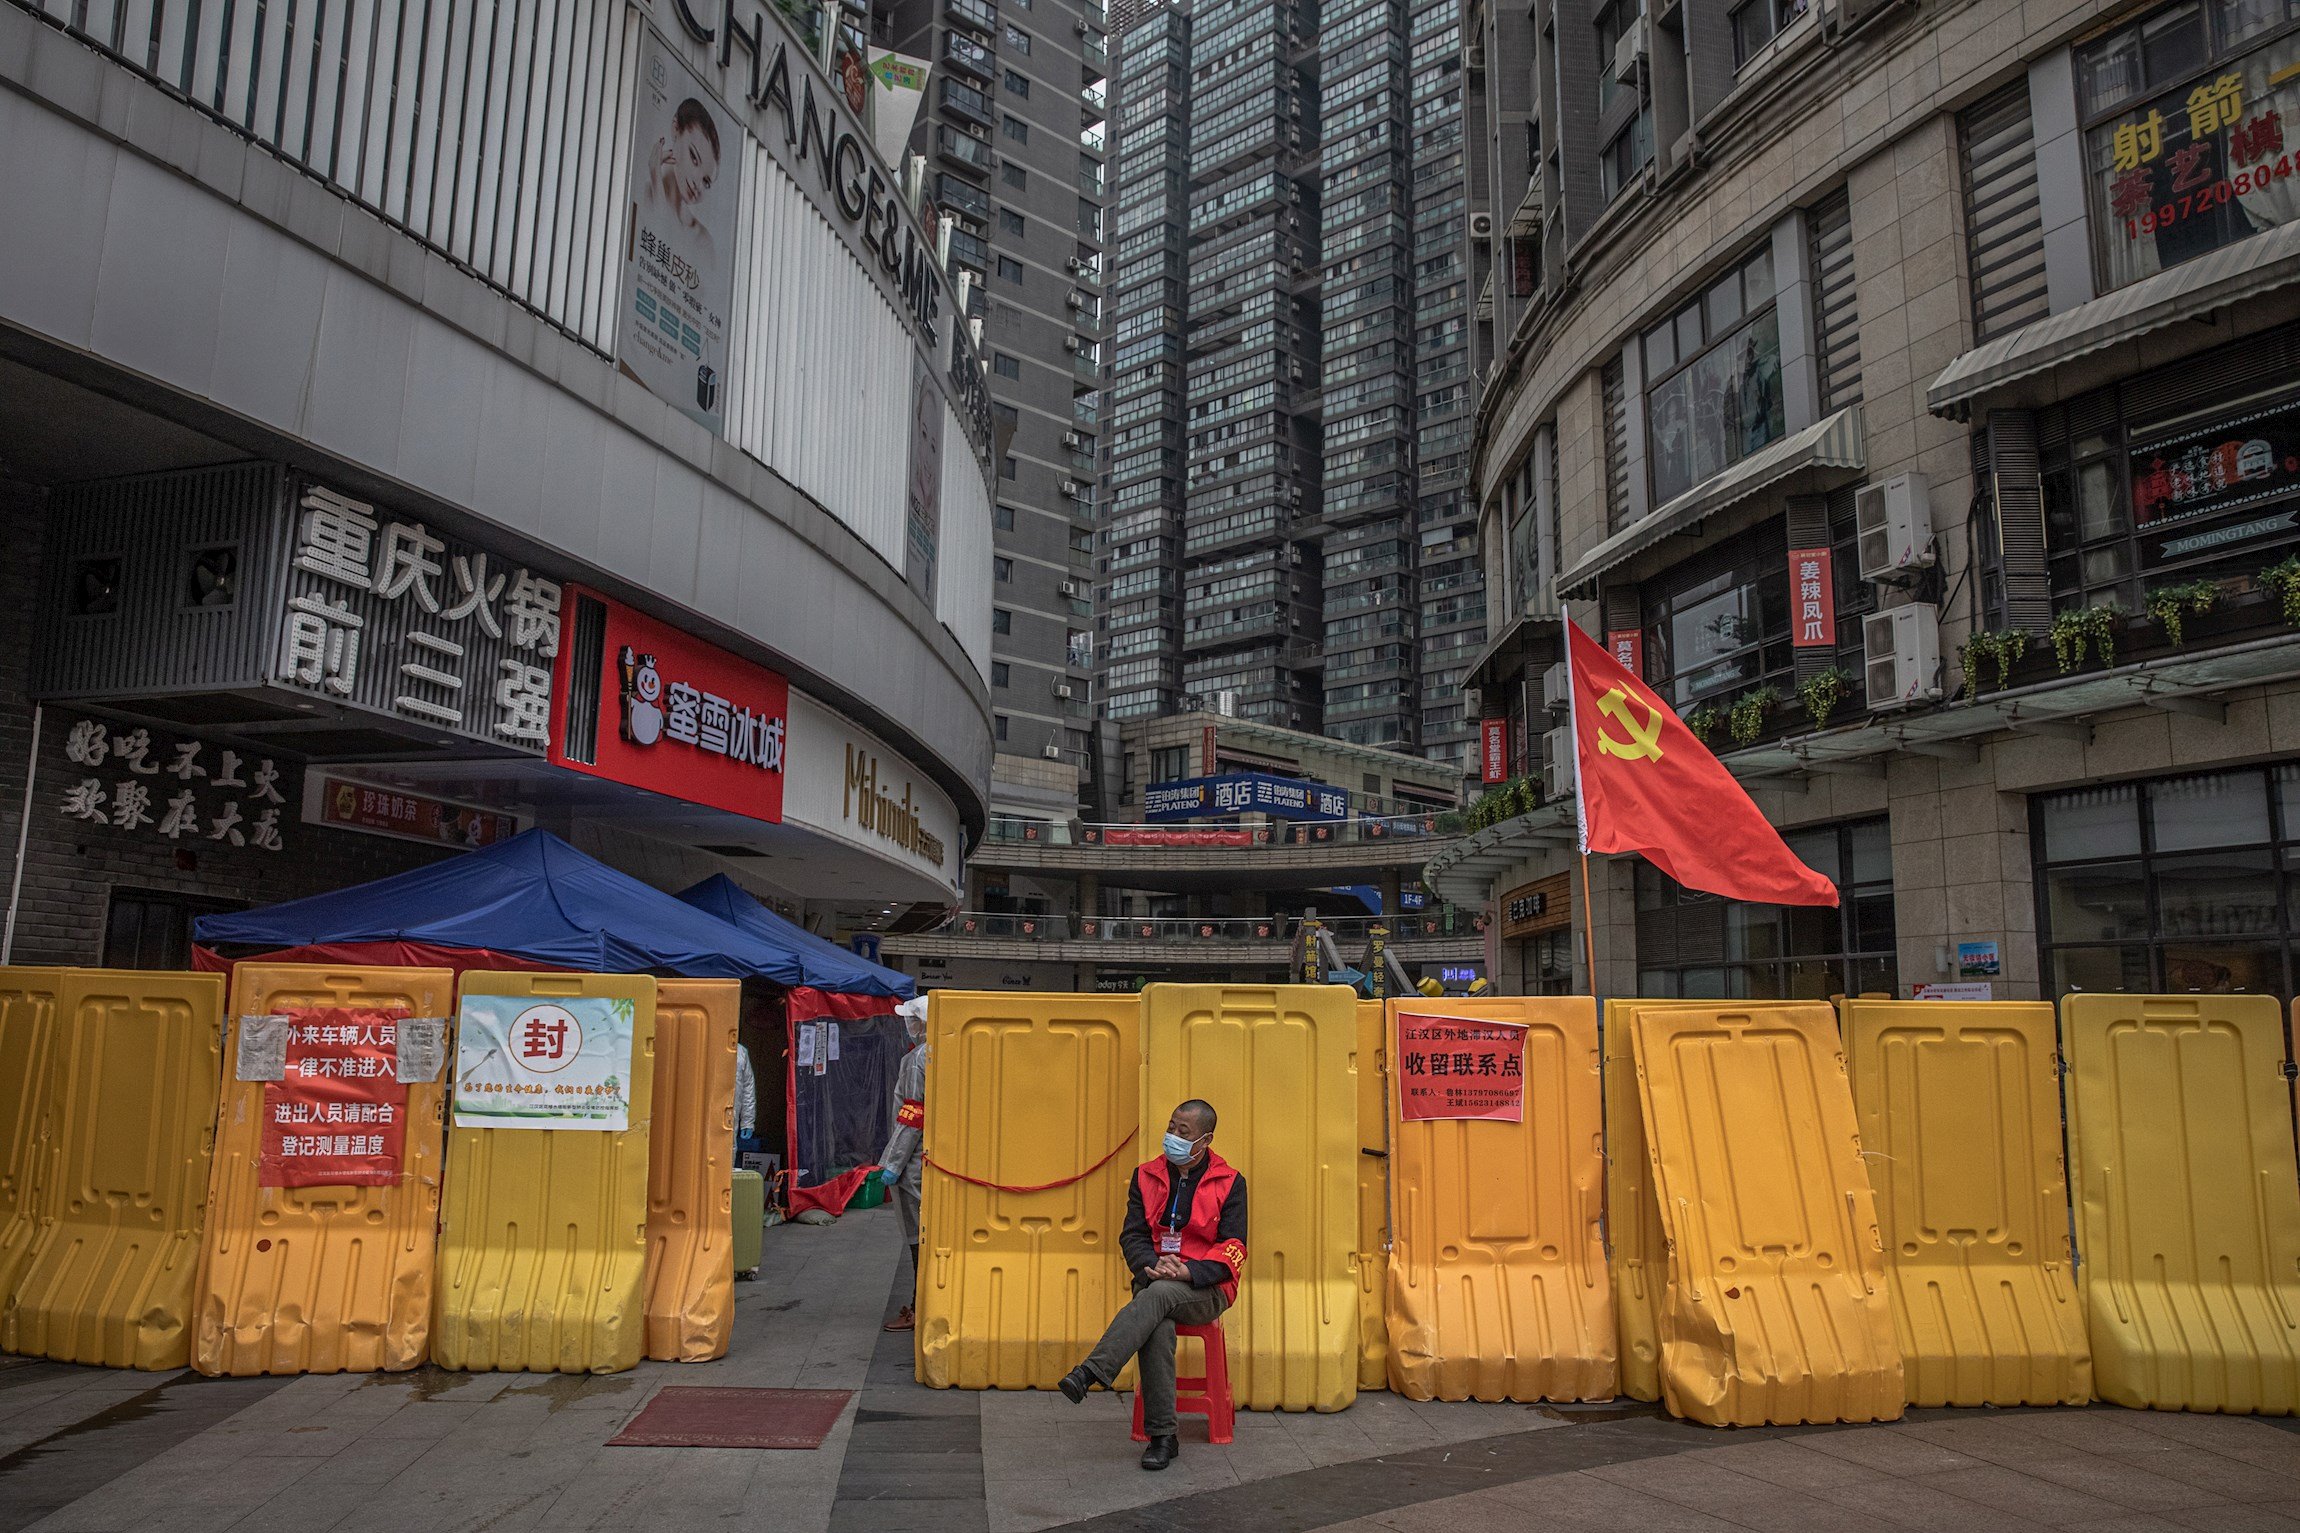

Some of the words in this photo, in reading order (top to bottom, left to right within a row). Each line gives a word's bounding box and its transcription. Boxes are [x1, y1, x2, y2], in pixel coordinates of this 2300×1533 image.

[2176, 518, 2279, 552] MOMINGTANG
[293, 485, 563, 658] 重庆火锅
[1799, 560, 1824, 641] 姜辣凤爪
[279, 592, 552, 748] 前三强
[666, 681, 785, 774] 蜜雪冰城
[66, 719, 287, 804] 好吃不上火
[362, 789, 419, 822] 珍珠奶茶
[1161, 799, 1200, 812] PLATENO
[1162, 786, 1200, 801] 铂涛集团
[1215, 781, 1252, 807] 酒店
[1273, 785, 1305, 800] 铂涛集团
[1320, 792, 1345, 817] 酒店
[1273, 796, 1305, 809] PLATENO
[1404, 893, 1423, 905] 1F-4F
[286, 1024, 397, 1046] 外来车辆人员
[522, 1018, 570, 1060] 封
[1405, 1028, 1520, 1041] 江汉区外地滞汉人员
[284, 1057, 396, 1078] 一律不准进入
[1405, 1051, 1522, 1077] 收留联系点
[274, 1102, 395, 1125] 进出人员请配合
[281, 1134, 385, 1157] 登记测量温度
